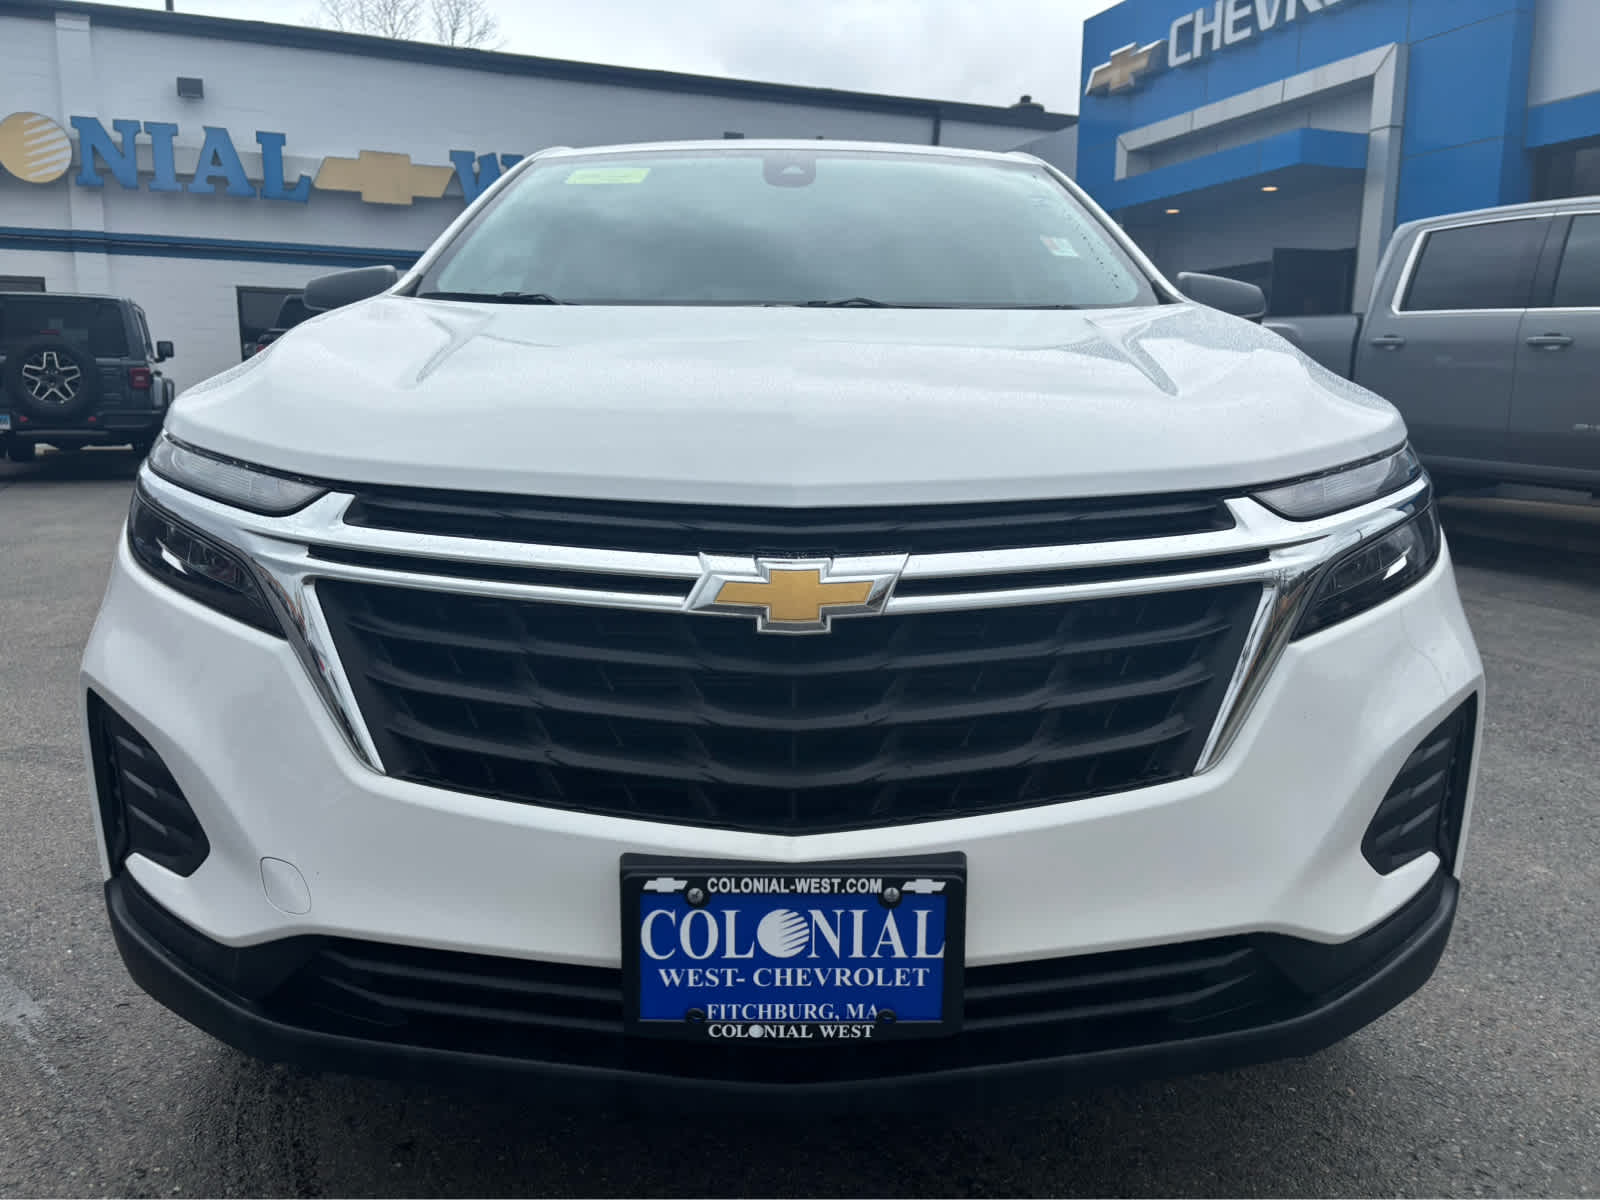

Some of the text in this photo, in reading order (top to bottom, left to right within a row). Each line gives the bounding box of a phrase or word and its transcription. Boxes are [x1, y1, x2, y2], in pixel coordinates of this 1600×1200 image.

[707, 877, 883, 894] COLONIAL-WEST.COM
[640, 908, 946, 960] COLONIAL
[753, 967, 930, 988] CHEVROLET
[707, 1003, 878, 1021] FITCHBURG, MA
[708, 1024, 875, 1038] COLONIAL WEST
